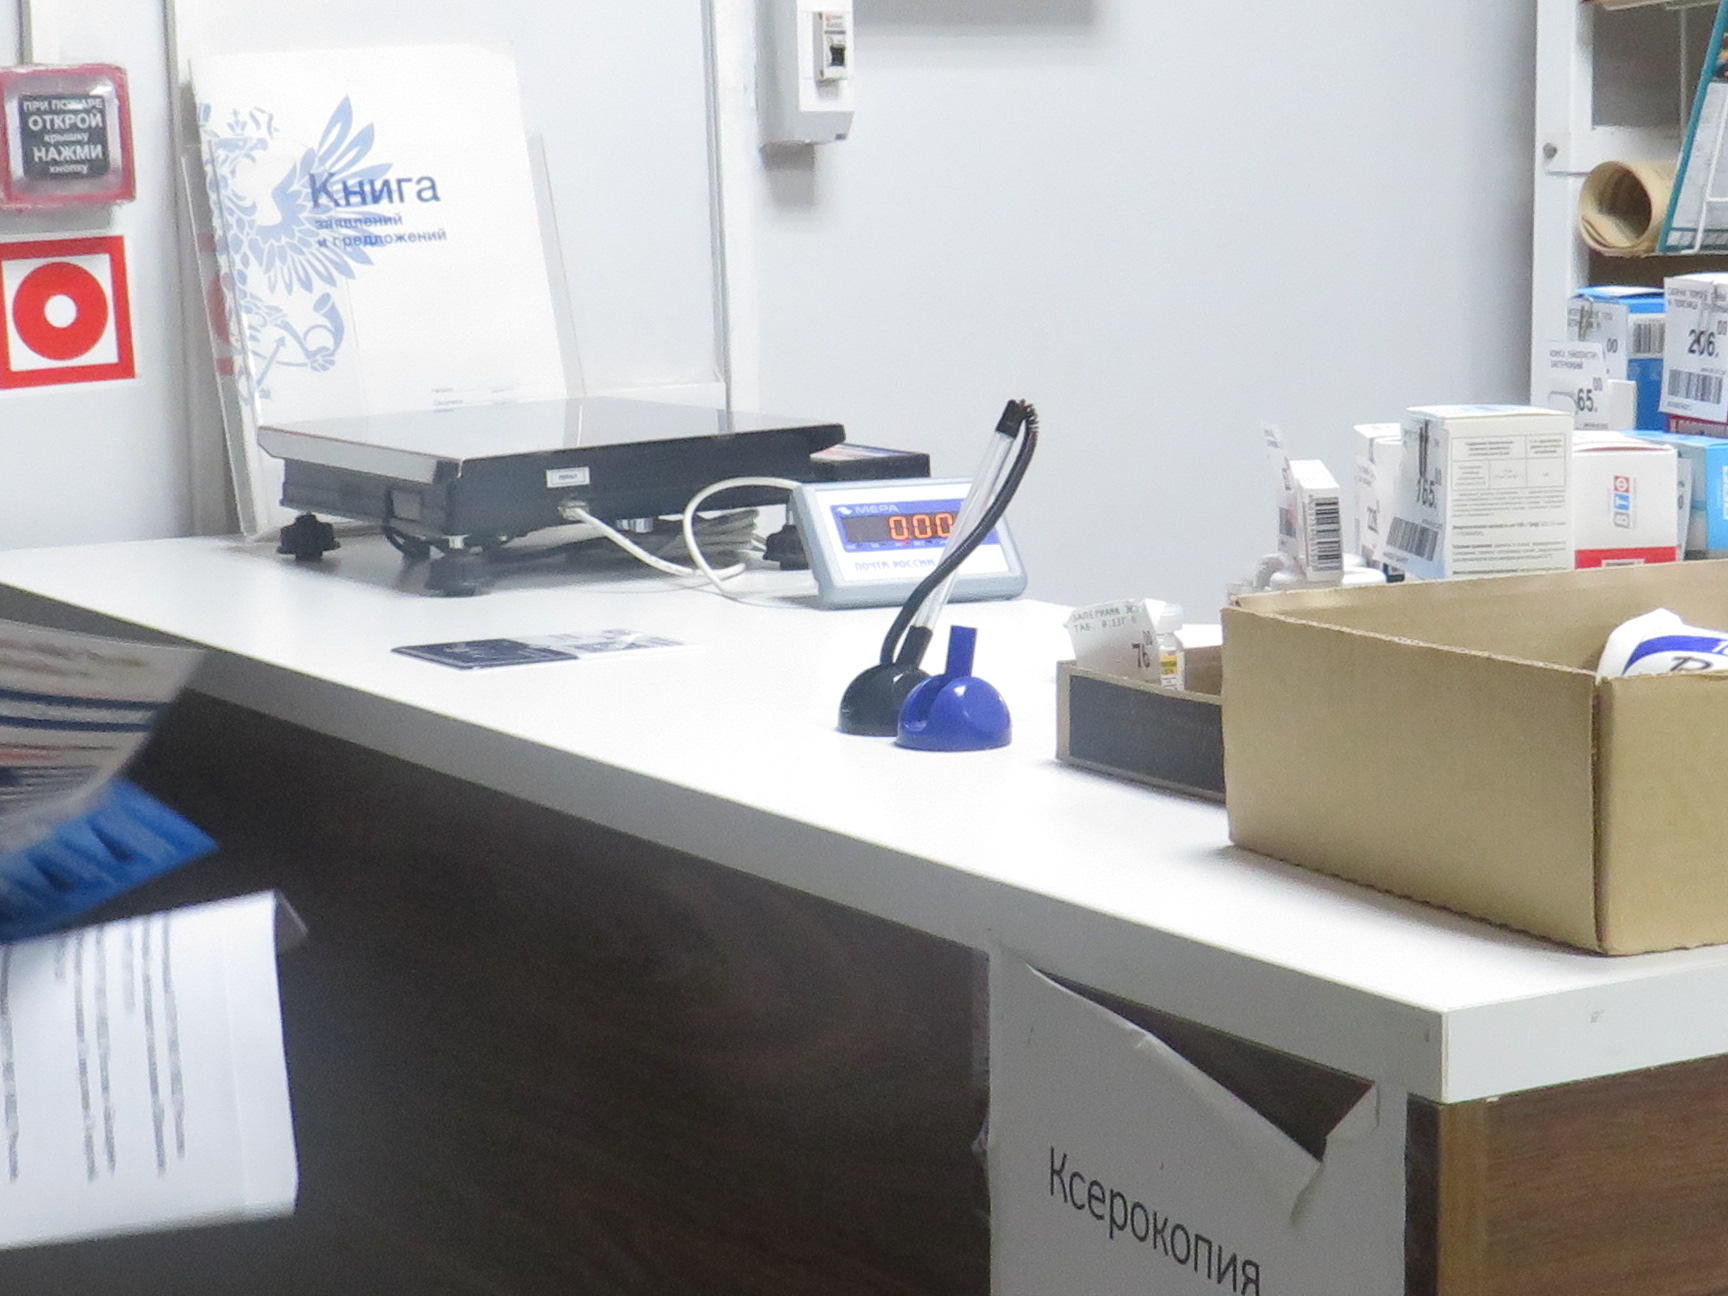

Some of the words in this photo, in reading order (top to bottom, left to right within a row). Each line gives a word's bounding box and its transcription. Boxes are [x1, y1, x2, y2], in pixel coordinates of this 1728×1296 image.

[23, 101, 50, 113] ПРИ
[51, 97, 104, 111] ПОАРЕ
[28, 110, 104, 131] ОТКРОЙ
[32, 144, 104, 163] НАЖМИ
[49, 163, 90, 175] кнопку
[308, 172, 442, 209] Книга
[314, 212, 404, 230] заявлений
[317, 237, 329, 248] и
[332, 227, 448, 248] предложений
[1687, 328, 1719, 357] 206.
[855, 503, 900, 515] МЕРА
[854, 558, 889, 572] ПОЧТА
[892, 557, 936, 570] РОССИИ
